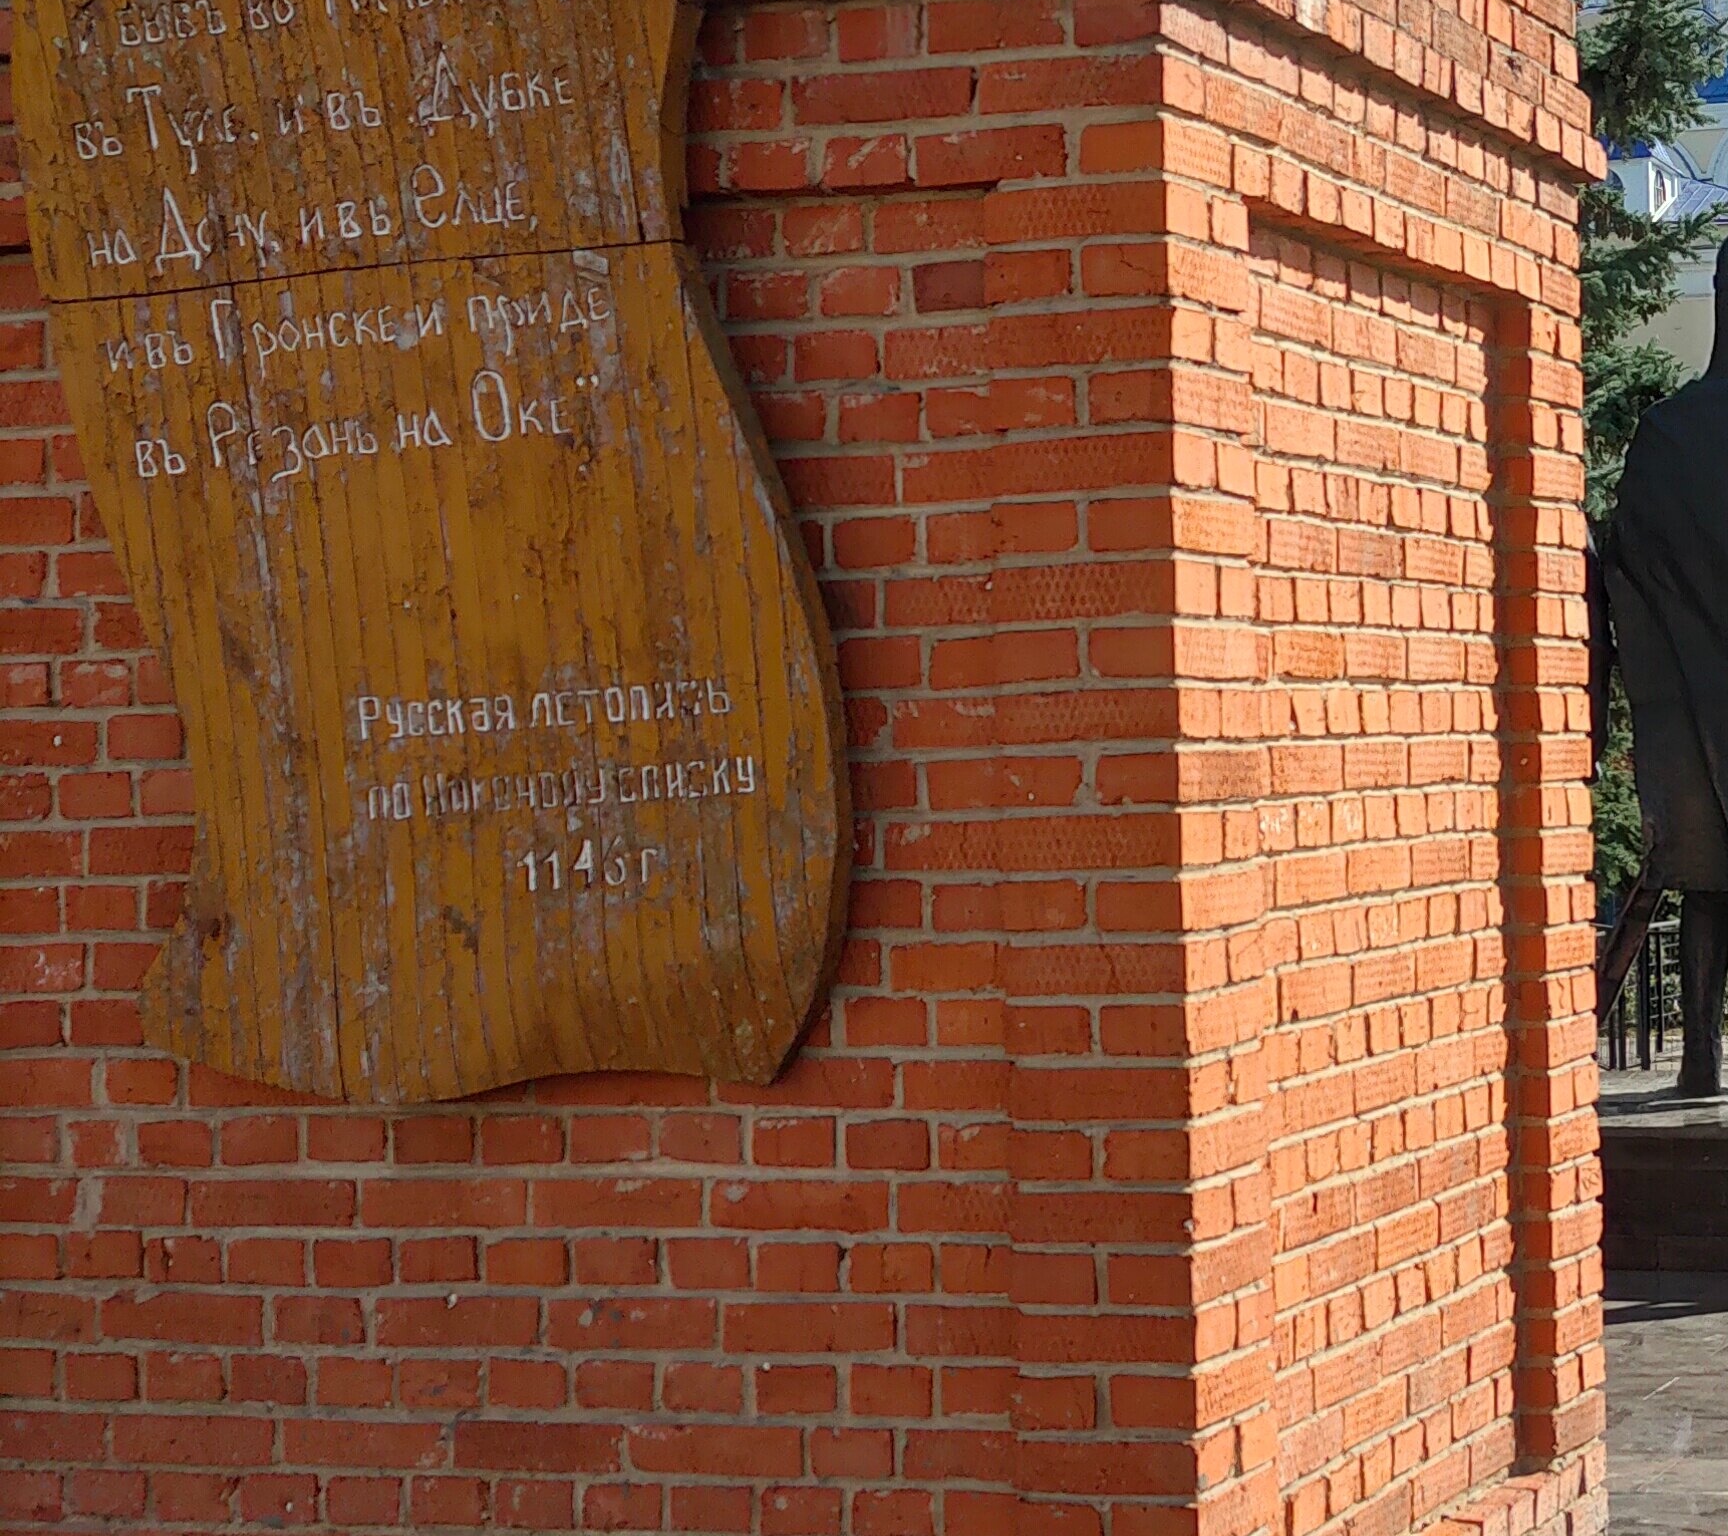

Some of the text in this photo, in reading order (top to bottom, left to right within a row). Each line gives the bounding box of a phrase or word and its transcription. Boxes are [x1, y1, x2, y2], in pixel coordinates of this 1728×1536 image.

[326, 91, 381, 130] въ
[415, 301, 444, 337] и
[467, 287, 611, 357] приде
[136, 439, 186, 477] въ
[207, 401, 378, 483] Резань
[397, 409, 452, 448] на
[358, 694, 517, 740] Русская
[368, 782, 412, 820] по
[617, 756, 757, 803] списку
